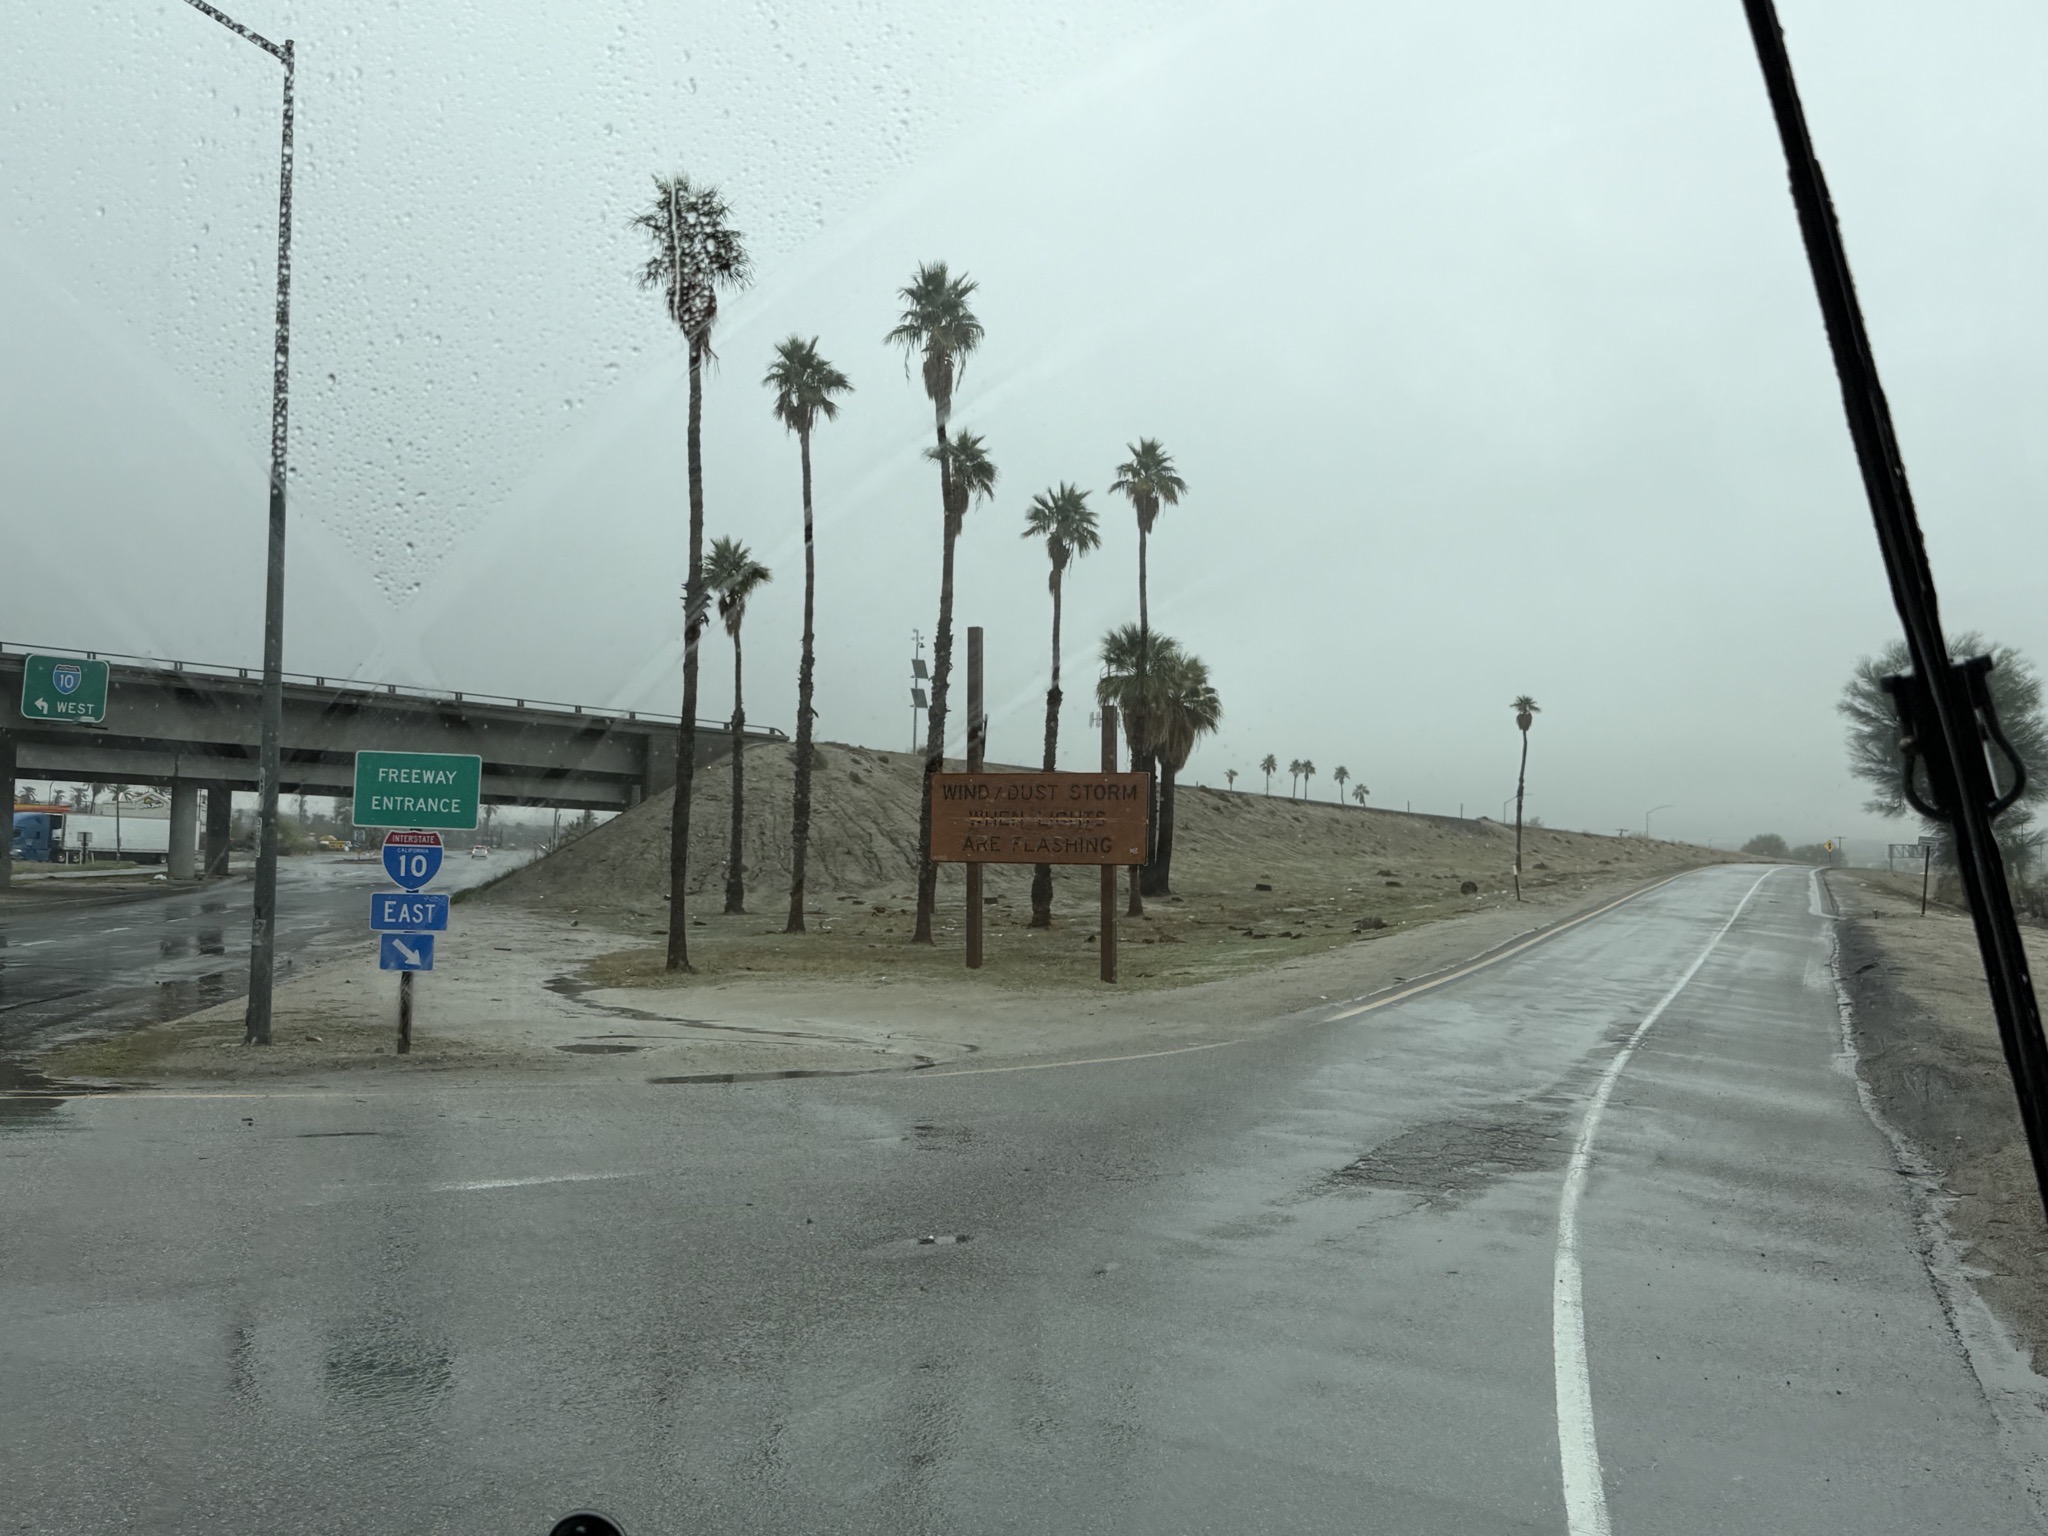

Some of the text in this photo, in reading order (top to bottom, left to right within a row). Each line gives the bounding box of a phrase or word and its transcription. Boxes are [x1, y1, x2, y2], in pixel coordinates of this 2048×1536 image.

[60, 674, 74, 688] 10
[56, 701, 94, 715] WEST
[379, 768, 457, 785] FREEWAY
[1069, 784, 1138, 801] STORM
[371, 796, 461, 813] ENTRANCE
[969, 810, 1107, 827] WHEN LIGHTS
[392, 835, 435, 844] INTERSTATE
[962, 836, 1112, 853] ARE FLASHING
[399, 855, 427, 877] 10
[384, 901, 435, 923] EAST
